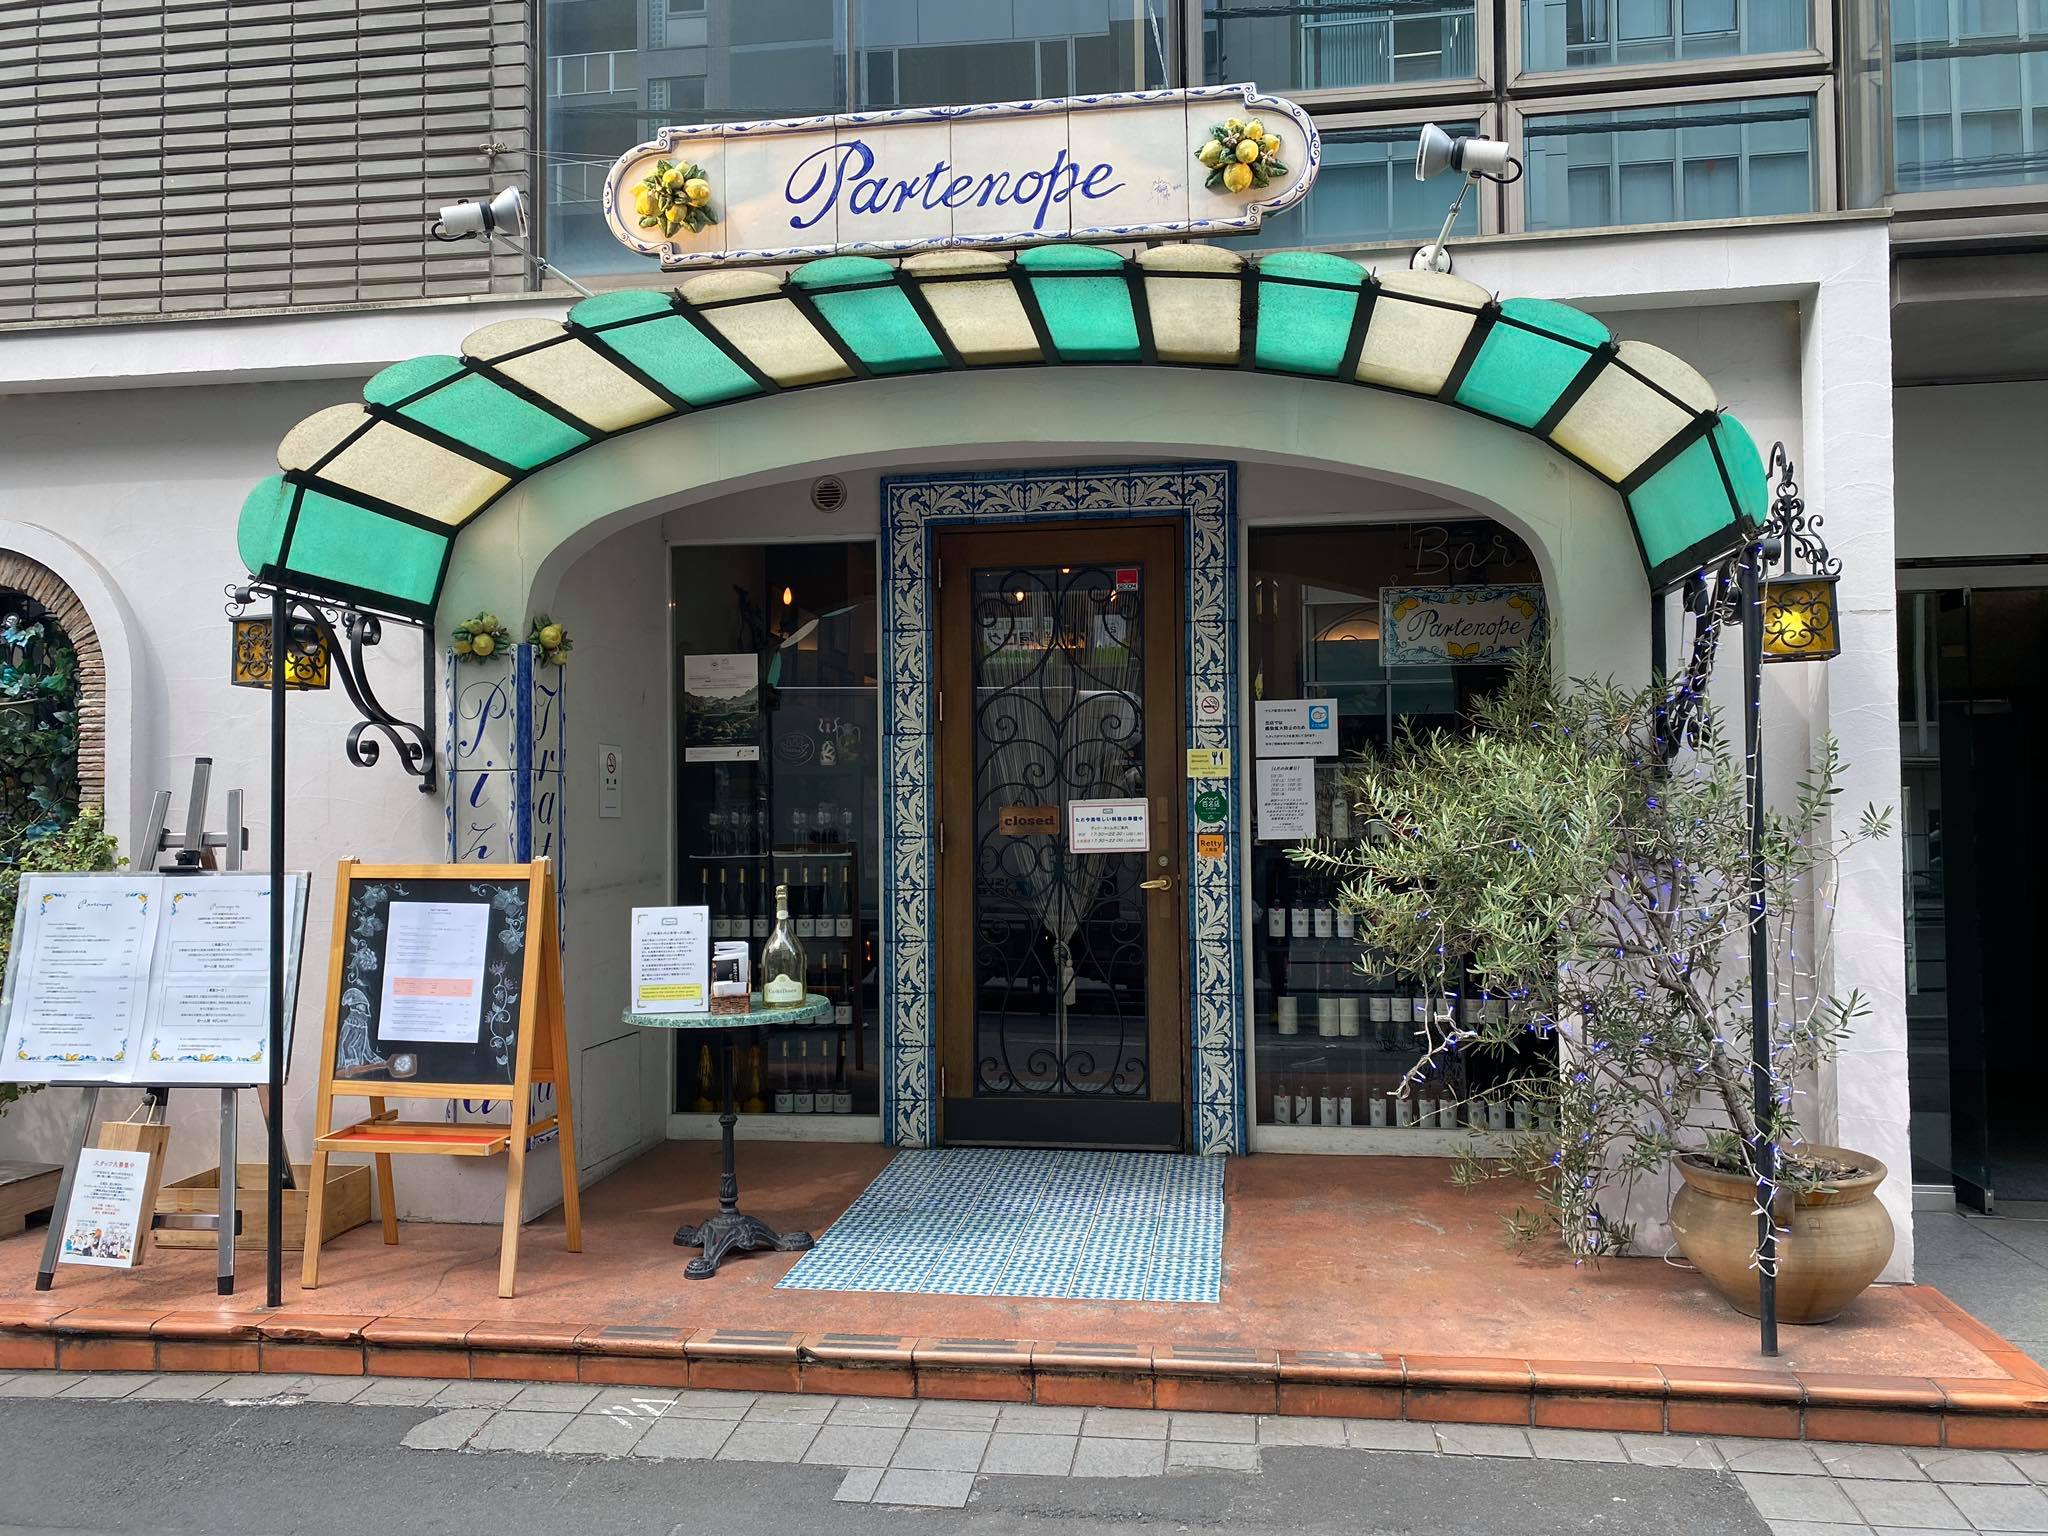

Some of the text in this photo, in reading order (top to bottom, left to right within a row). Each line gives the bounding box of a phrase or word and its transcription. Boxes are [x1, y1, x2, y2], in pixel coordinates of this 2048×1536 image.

[785, 138, 1126, 229] Partenope
[1412, 526, 1518, 576] Bar
[1406, 608, 1525, 644] Partenope
[1004, 815, 1056, 827] closed
[1200, 840, 1222, 848] Retty
